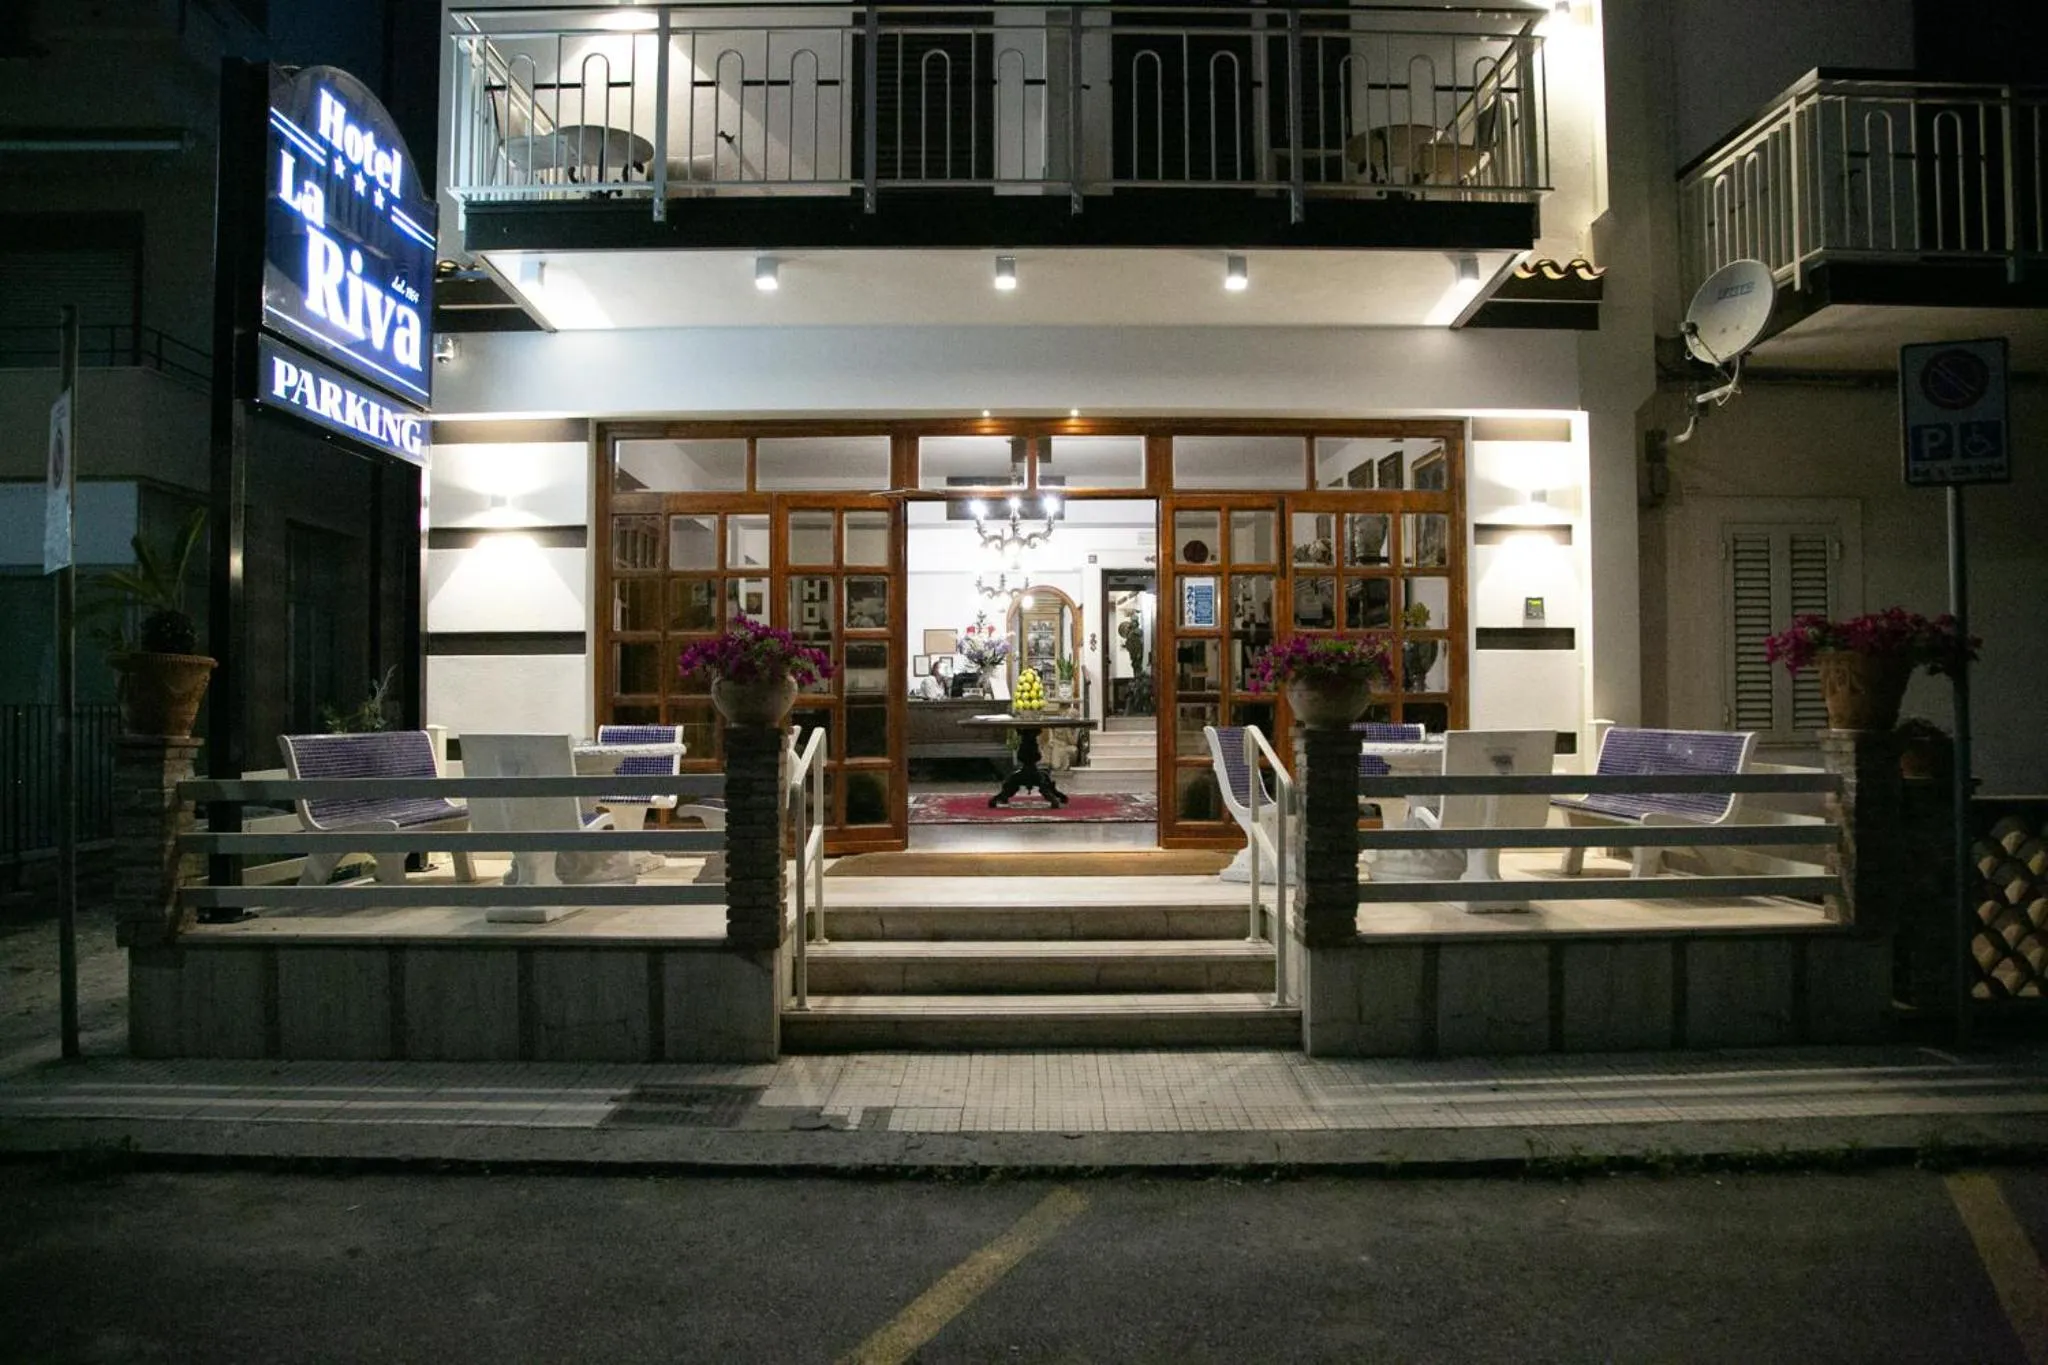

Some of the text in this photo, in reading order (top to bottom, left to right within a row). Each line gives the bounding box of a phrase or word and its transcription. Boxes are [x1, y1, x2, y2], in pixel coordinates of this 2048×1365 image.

[278, 149, 326, 229] La
[318, 88, 402, 200] Hotel
[305, 226, 423, 372] Riva
[271, 355, 423, 457] PARKING
